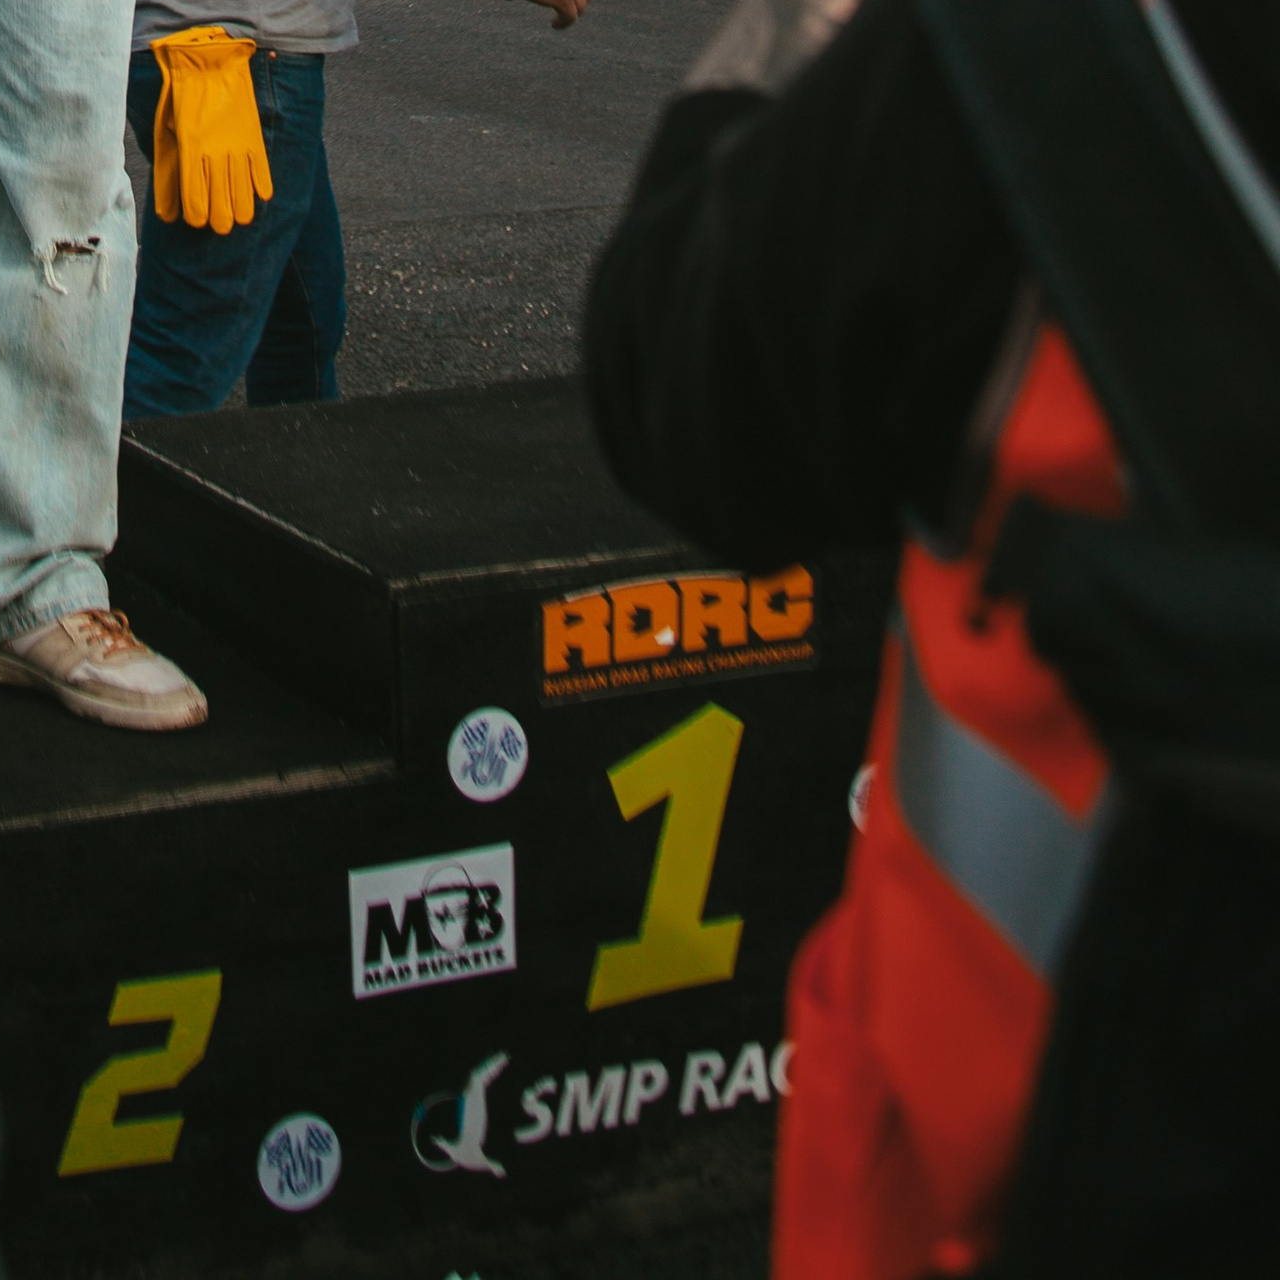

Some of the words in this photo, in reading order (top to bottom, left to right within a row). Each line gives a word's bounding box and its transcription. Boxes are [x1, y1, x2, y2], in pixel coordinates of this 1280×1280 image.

[541, 562, 814, 675] RDRC
[543, 671, 608, 698] RUSSIAN
[610, 663, 651, 688] DRAG
[651, 655, 706, 681] RACING
[586, 700, 745, 1013] 1
[363, 964, 413, 991] MAD
[417, 944, 506, 979] BUCKETS
[57, 968, 223, 1178] 2
[514, 1059, 669, 1144] SMP
[679, 1042, 796, 1116] RAC
